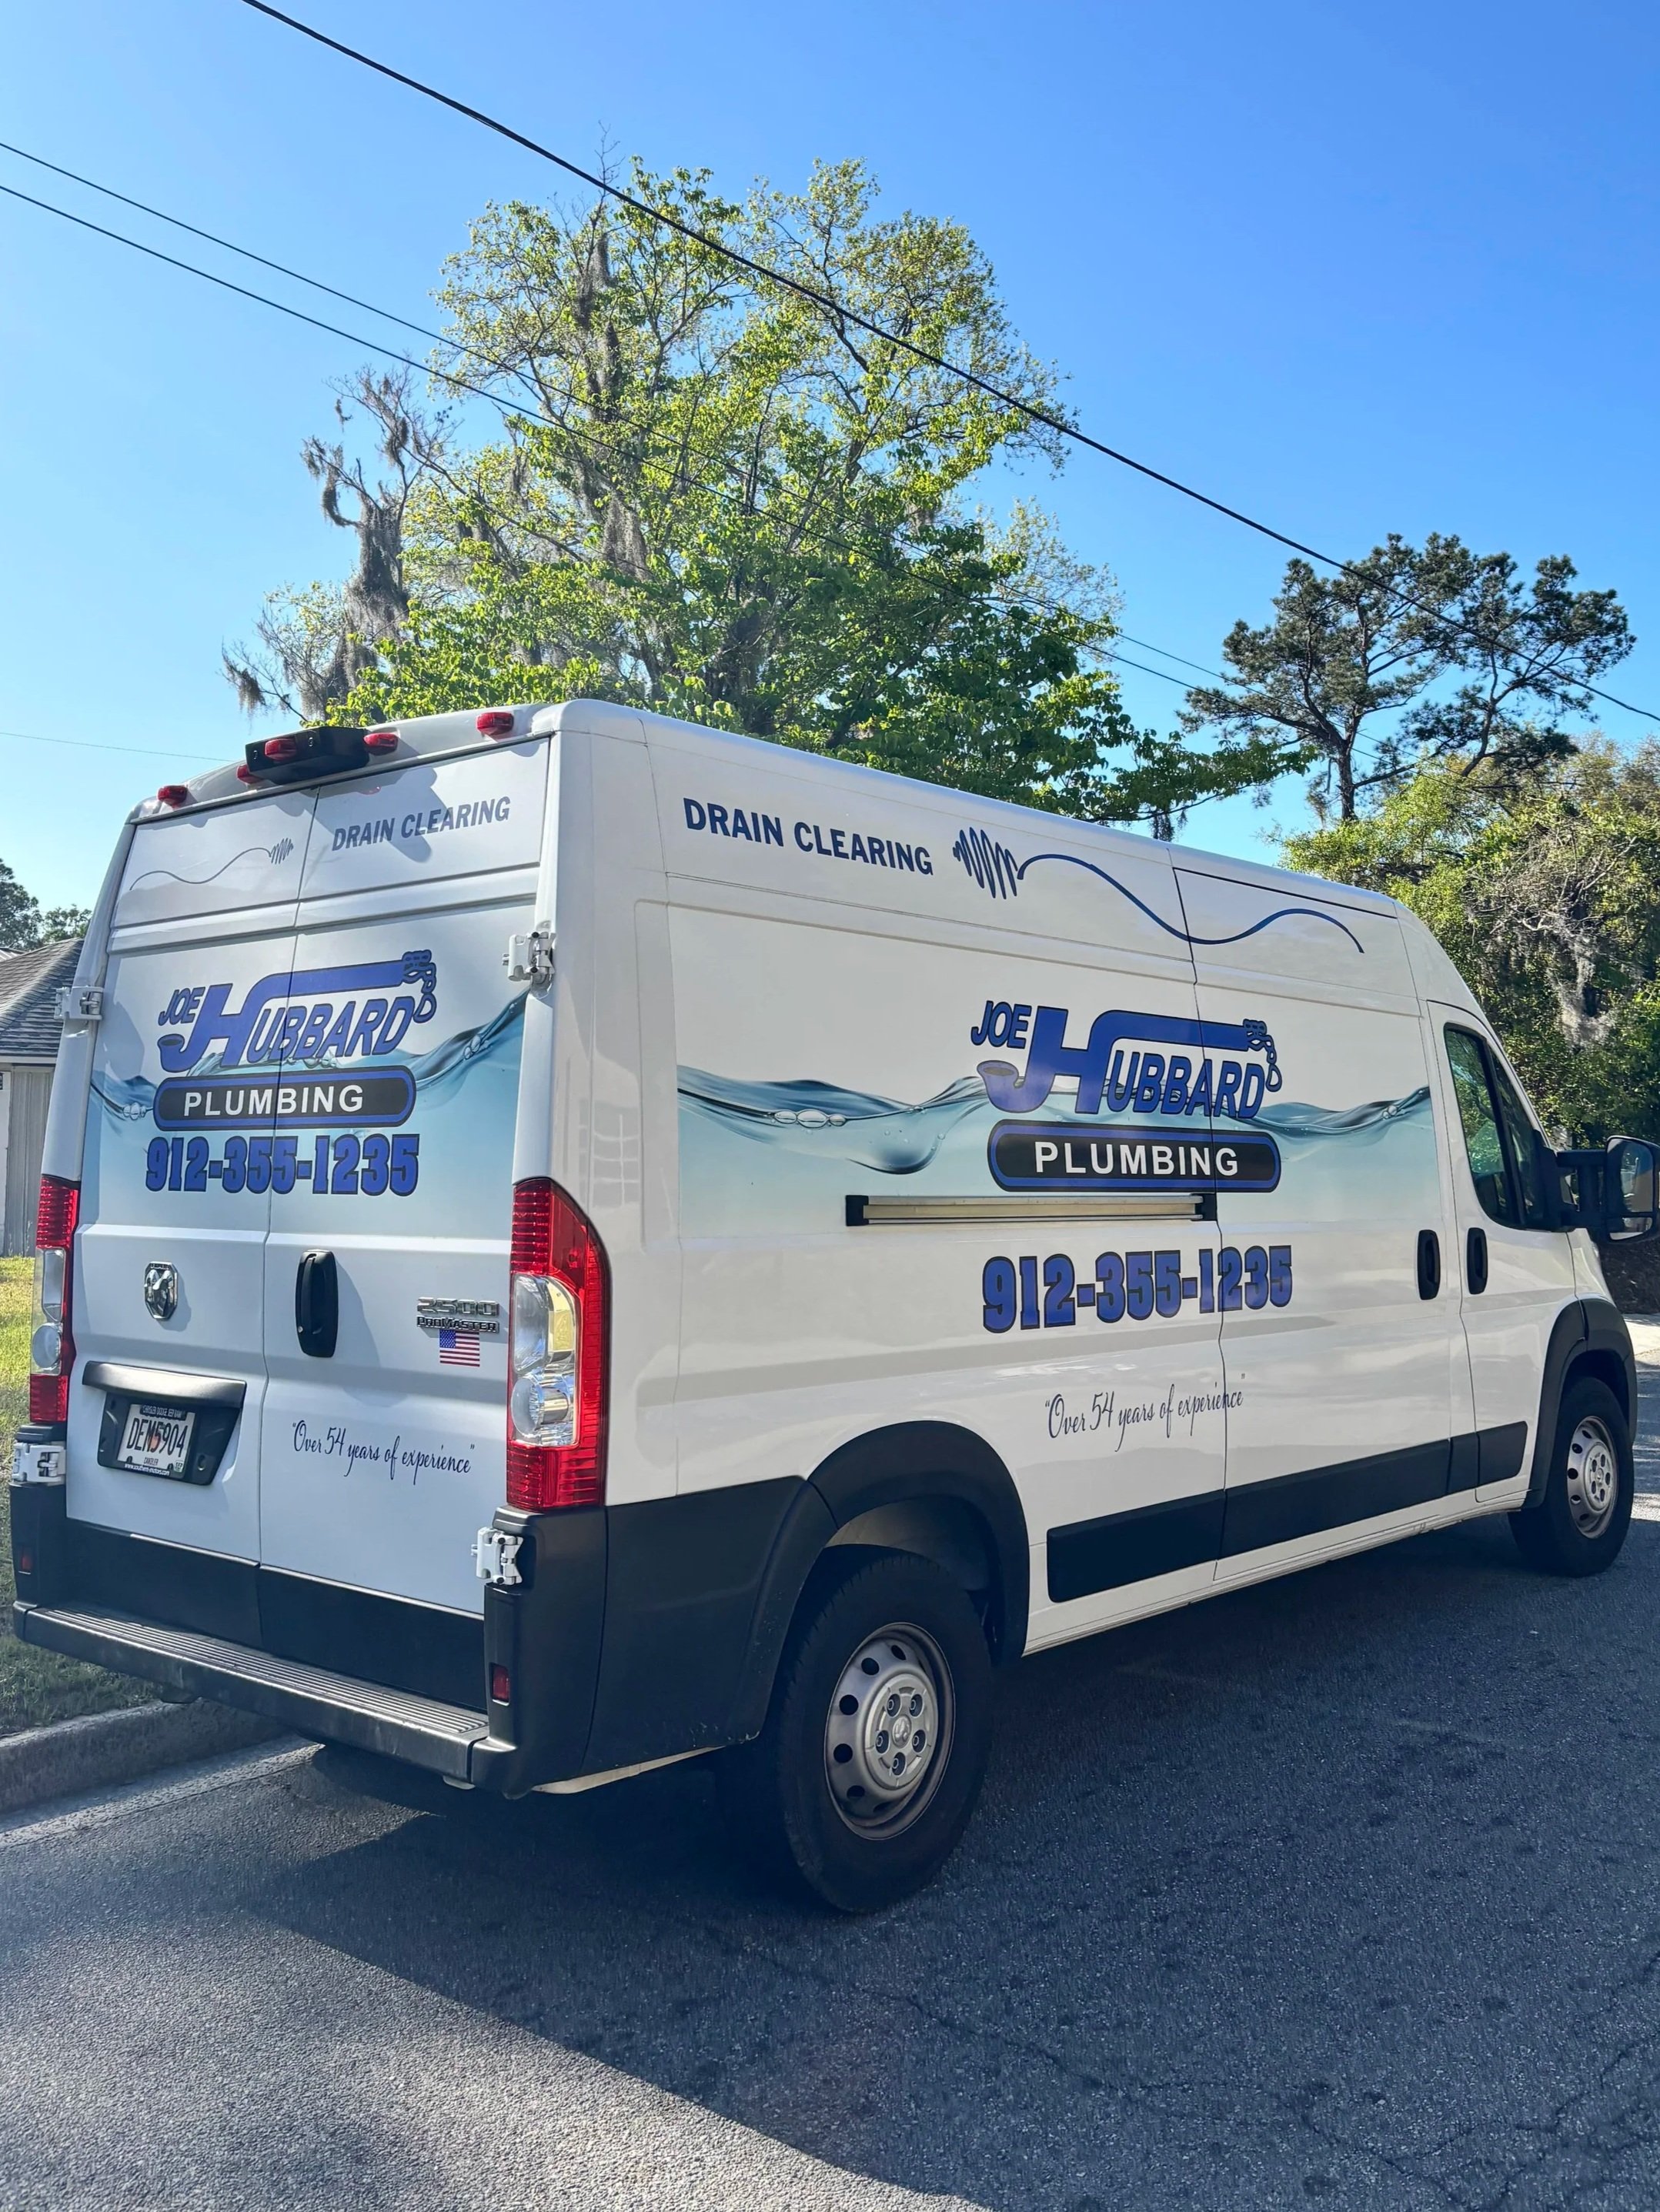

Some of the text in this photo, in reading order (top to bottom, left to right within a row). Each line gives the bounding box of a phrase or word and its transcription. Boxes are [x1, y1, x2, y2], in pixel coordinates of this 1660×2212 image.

[332, 796, 512, 852] DRAIN CLEARING
[683, 797, 934, 876] DRAIN CLEARING
[157, 959, 418, 1073] HUBBARD
[158, 986, 205, 1026] JOE
[970, 1000, 1031, 1049] JOE
[976, 1005, 1266, 1119] HUBBARD
[183, 1085, 363, 1117] PLUMBING
[145, 1133, 420, 1197] 912-355-1235
[1034, 1141, 1238, 1176] PLUMBING
[417, 1296, 499, 1316] 2500
[982, 1244, 1293, 1333] 912-355-1235
[1090, 1391, 1115, 1431] 54
[1114, 1403, 1154, 1453] years
[1159, 1383, 1175, 1438] of
[325, 1426, 346, 1456] 54
[343, 1444, 380, 1477] years
[384, 1436, 400, 1480] of
